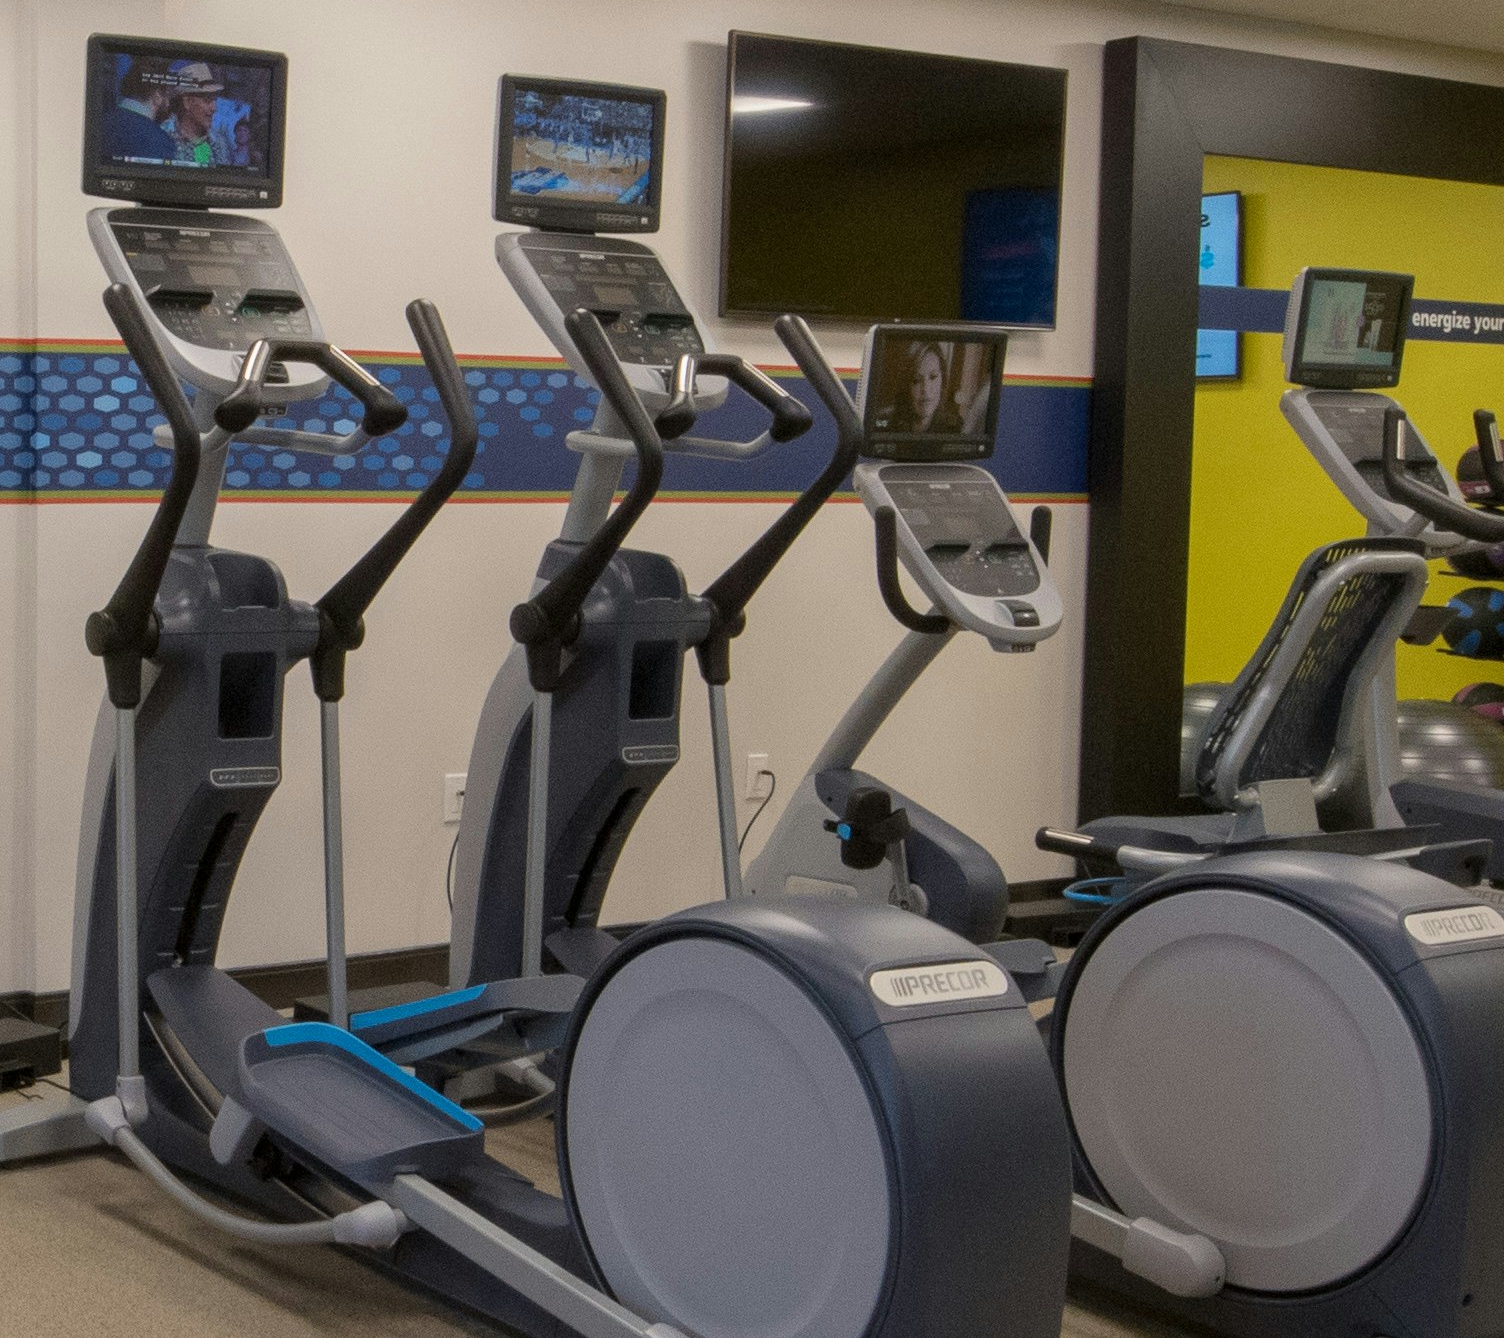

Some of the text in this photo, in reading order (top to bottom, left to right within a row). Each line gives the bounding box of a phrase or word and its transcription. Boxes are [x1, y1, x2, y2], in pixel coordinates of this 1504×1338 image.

[1412, 310, 1471, 333] energize
[1474, 316, 1504, 335] your
[1431, 912, 1495, 938] PRECOR
[903, 969, 991, 997] PRECOR
